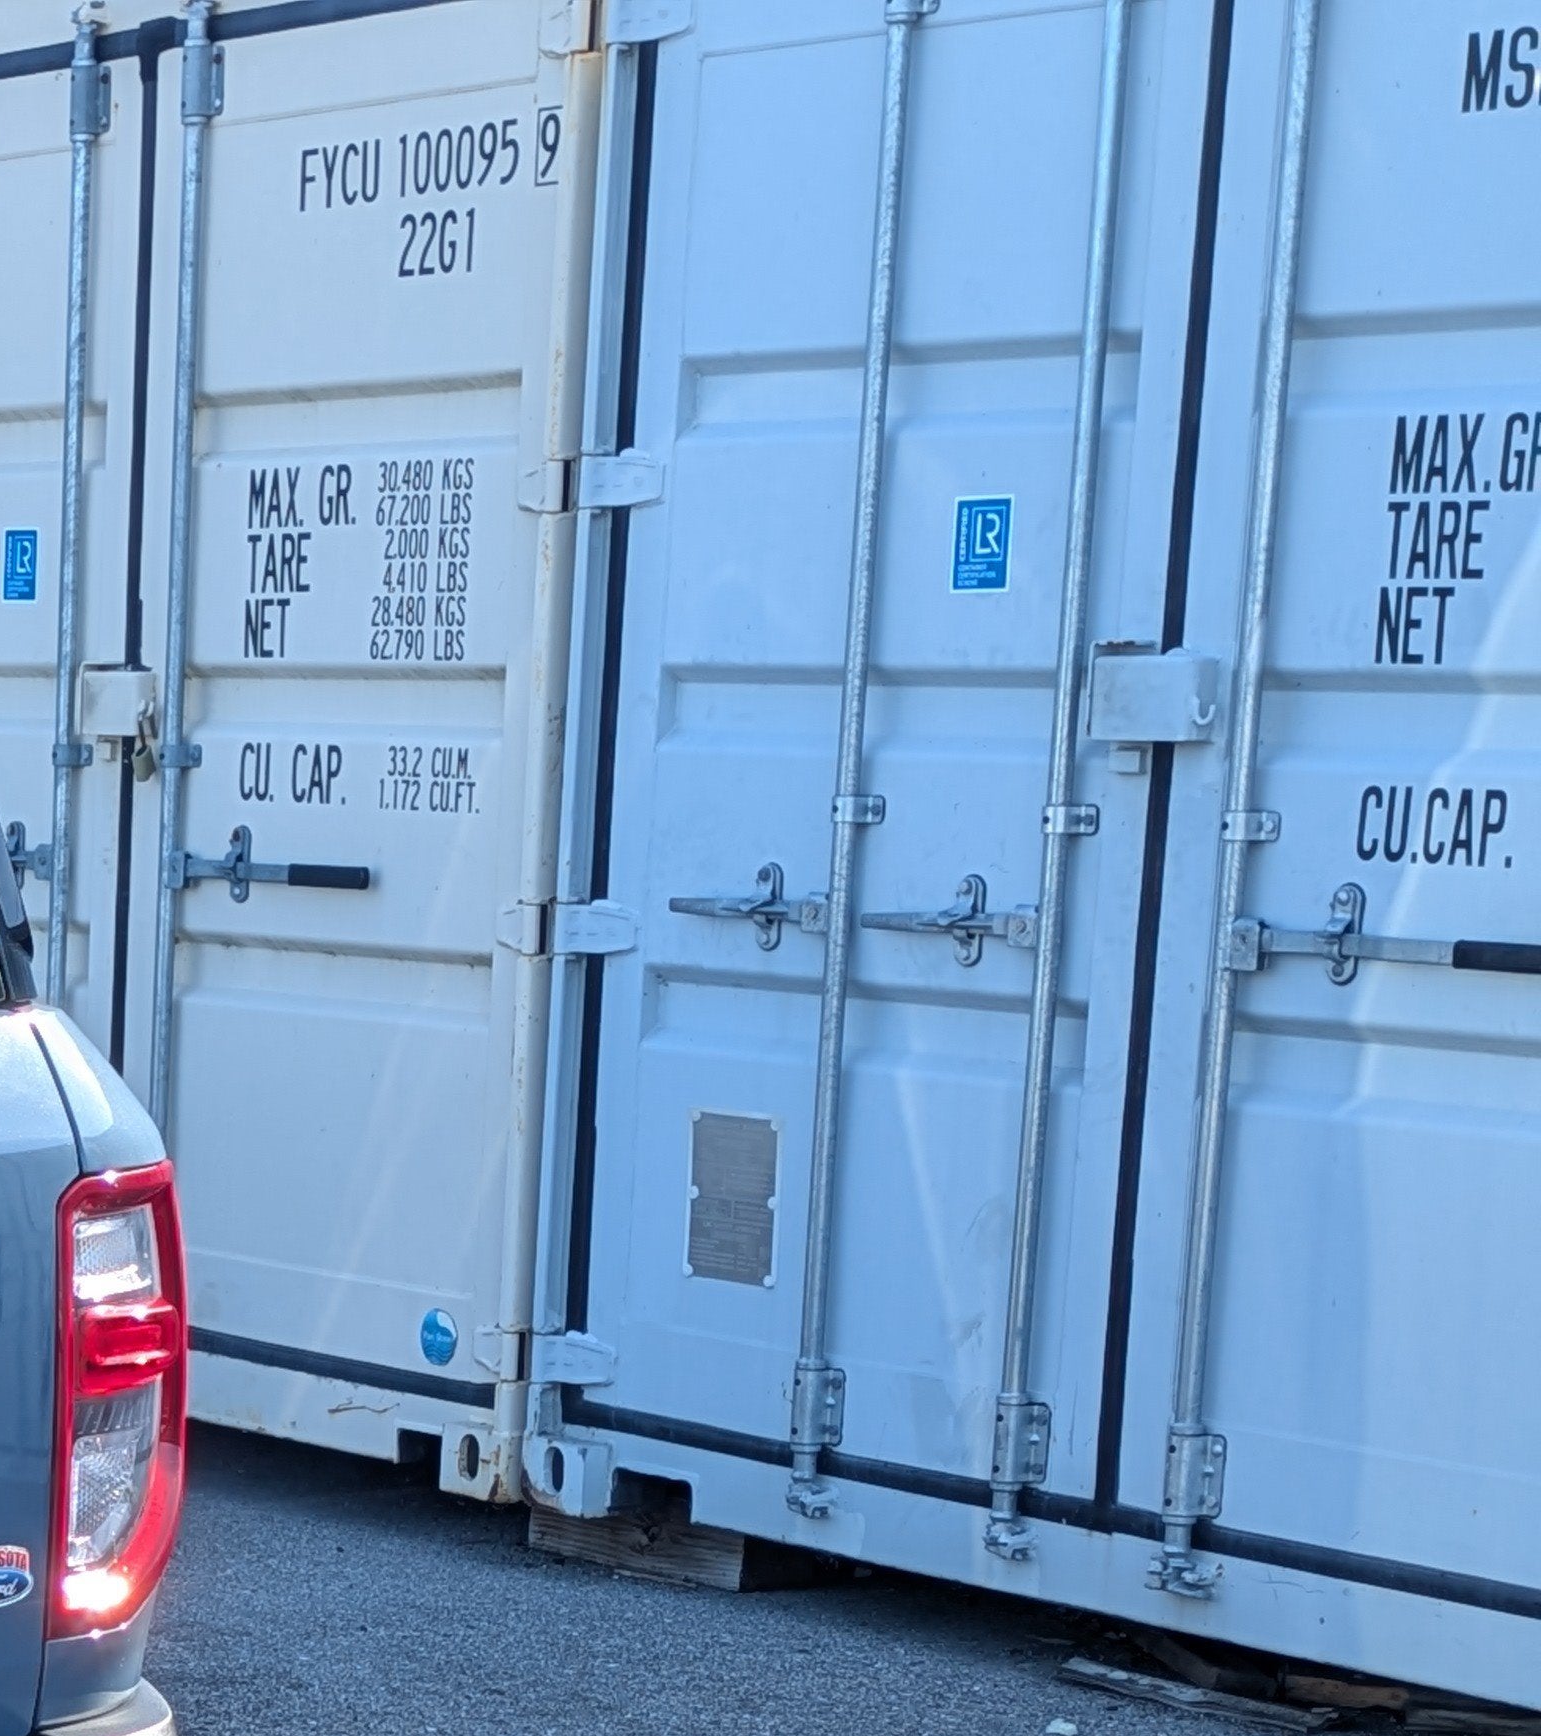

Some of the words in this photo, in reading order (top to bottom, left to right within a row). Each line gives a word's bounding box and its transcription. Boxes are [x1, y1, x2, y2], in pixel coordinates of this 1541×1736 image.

[1461, 26, 1541, 114] MS
[300, 138, 381, 212] FYCU
[398, 118, 519, 198] 100095
[540, 112, 561, 179] 9
[397, 207, 476, 278] 22G1
[248, 466, 305, 529] MAX.
[318, 463, 357, 526] GR.
[441, 457, 475, 491] KGS
[439, 492, 473, 526] LBS
[247, 532, 312, 594] TARE
[437, 526, 471, 560] KGS
[1387, 500, 1491, 580] TARE
[435, 561, 469, 594] LBS
[243, 597, 292, 659] NET
[434, 595, 467, 628] KGS
[433, 629, 466, 662] LBS
[1374, 586, 1456, 665] NET
[239, 741, 275, 803] CU.
[291, 743, 347, 805] CAP.
[387, 745, 423, 778] 33.2
[431, 747, 473, 780] CU.M.
[429, 780, 480, 814] CU.FT.
